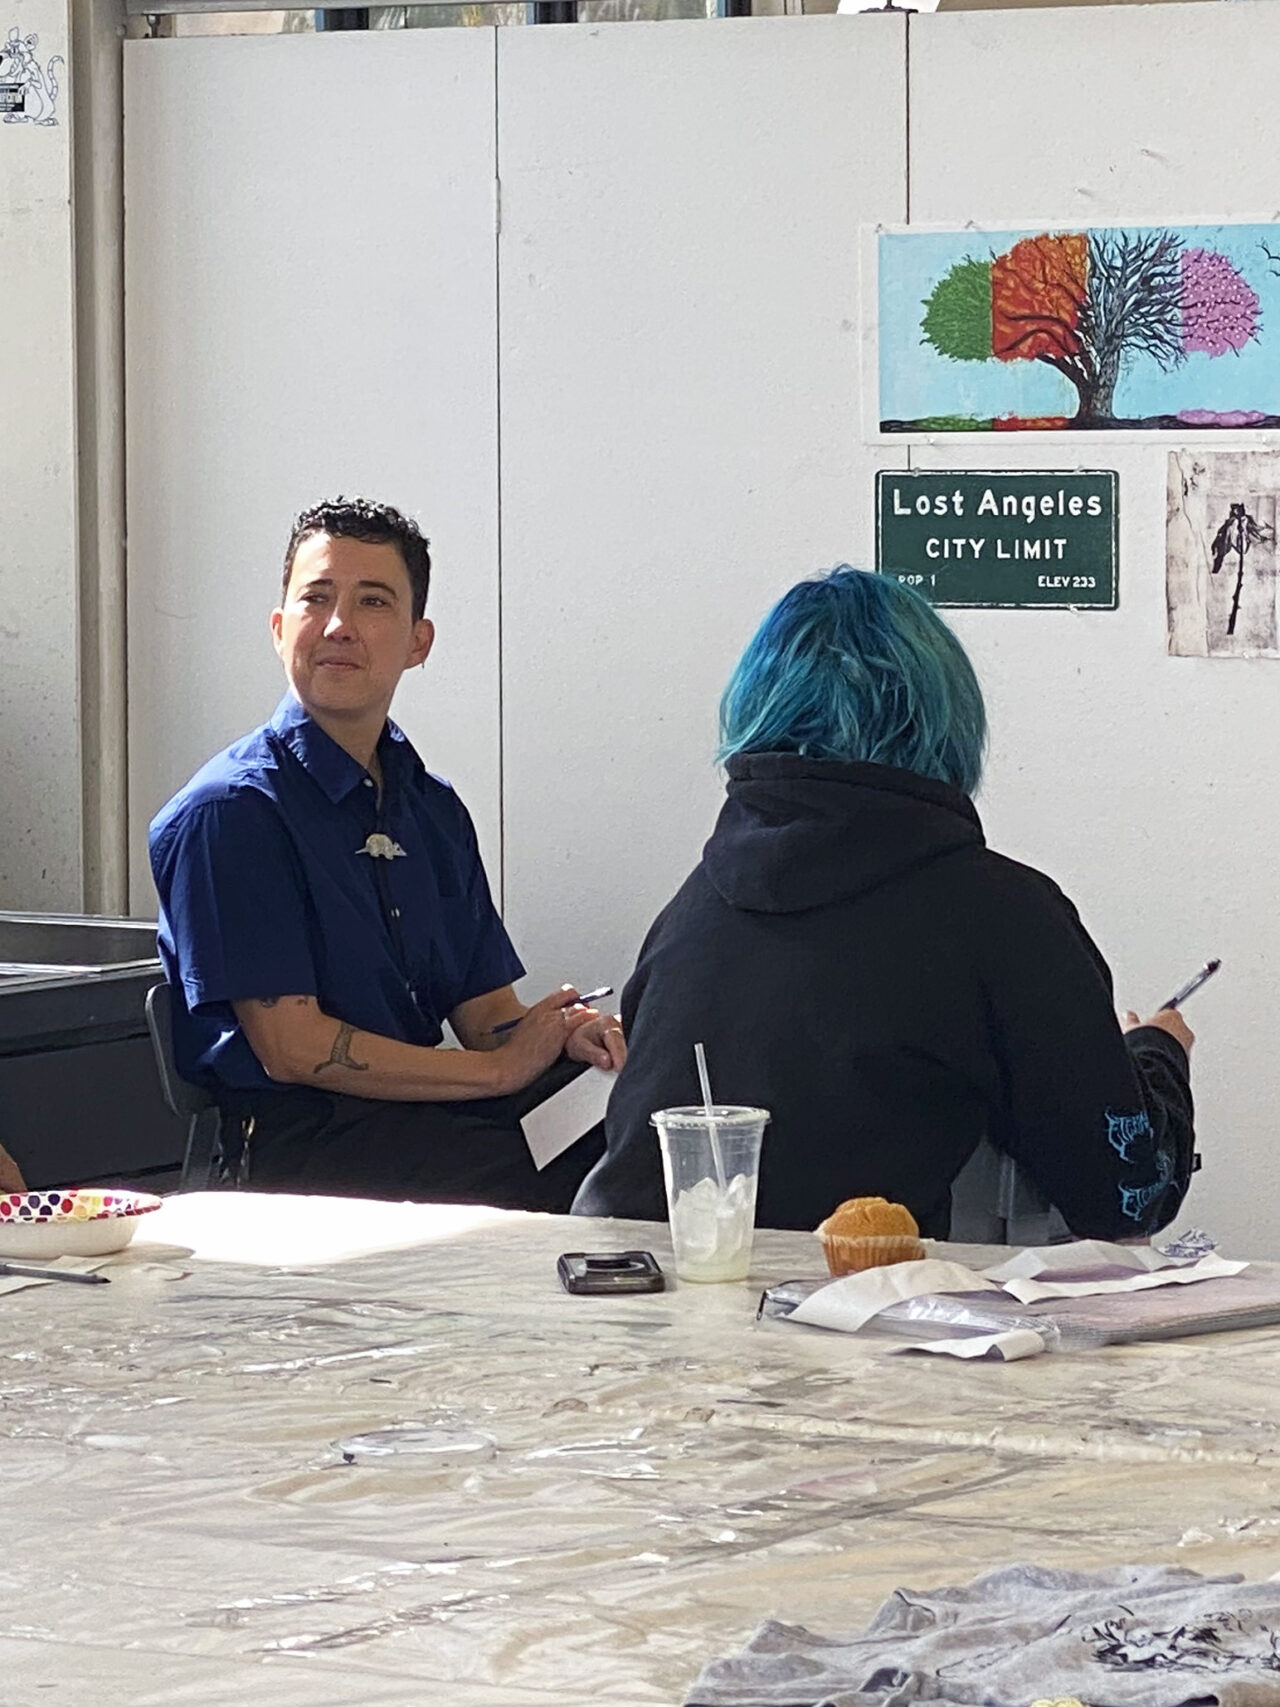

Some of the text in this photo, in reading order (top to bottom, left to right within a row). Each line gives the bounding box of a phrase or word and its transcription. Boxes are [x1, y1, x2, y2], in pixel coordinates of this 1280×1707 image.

[893, 488, 1102, 523] Lost Angeles
[926, 538, 1067, 559] CITY LIMIT
[897, 574, 936, 587] POP 1
[1038, 576, 1096, 588] ELEV 233
